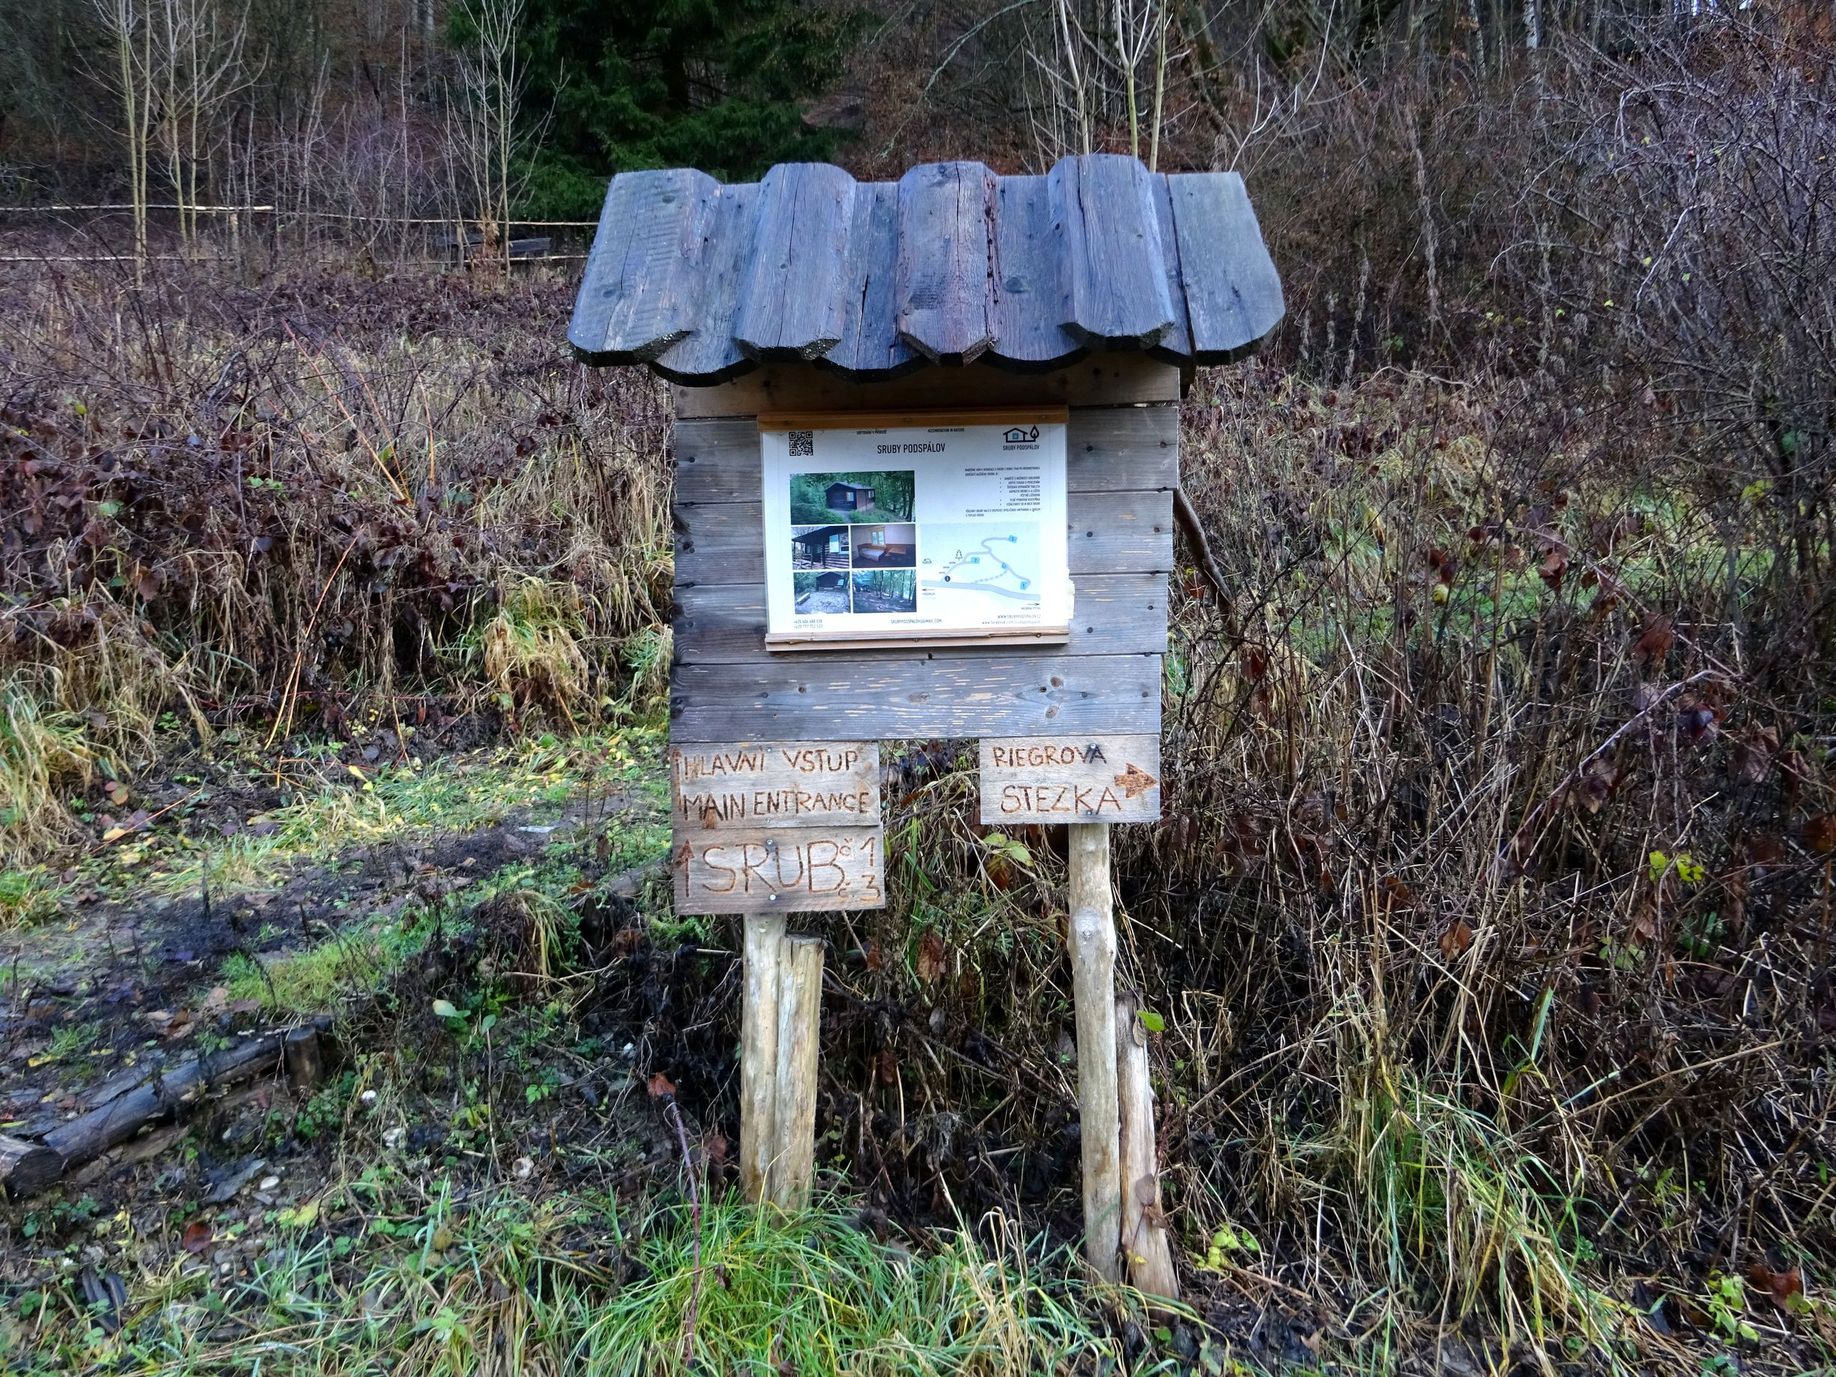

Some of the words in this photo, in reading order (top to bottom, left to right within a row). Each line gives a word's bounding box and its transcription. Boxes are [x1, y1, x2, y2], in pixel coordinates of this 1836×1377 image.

[877, 444, 901, 454] SRUBY
[903, 441, 946, 453] PODSPÁLOV
[783, 749, 859, 773] VSTUP
[992, 745, 1107, 767] RIEGROVA
[683, 792, 746, 821] MAIN
[753, 788, 870, 815] ENTRANCE
[1000, 784, 1122, 815] STEZKA
[702, 838, 845, 894] SRUB
[860, 836, 876, 867] 1
[860, 874, 881, 902] 3
